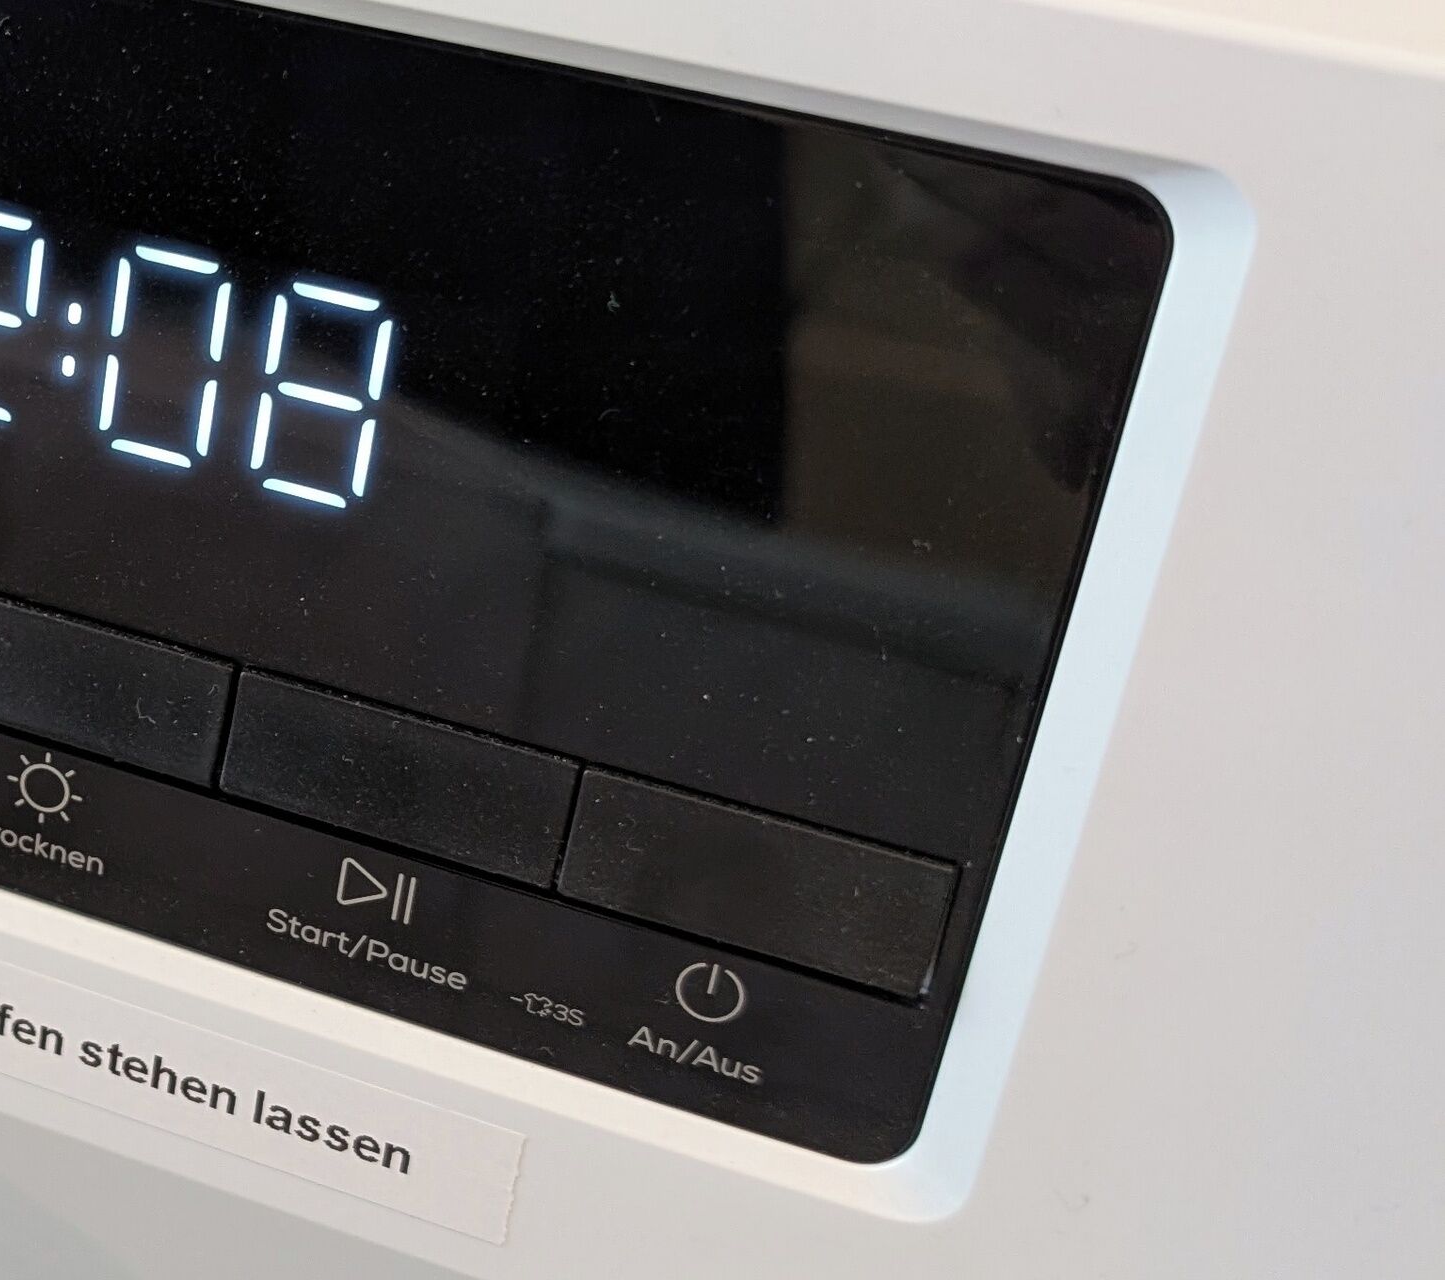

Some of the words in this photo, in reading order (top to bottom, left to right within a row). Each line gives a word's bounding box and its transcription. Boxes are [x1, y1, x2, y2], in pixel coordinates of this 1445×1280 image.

[266, 907, 468, 991] Start/Pause
[627, 1025, 764, 1085] An/Aus
[78, 1039, 238, 1116] stehen
[252, 1089, 412, 1175] lassen
